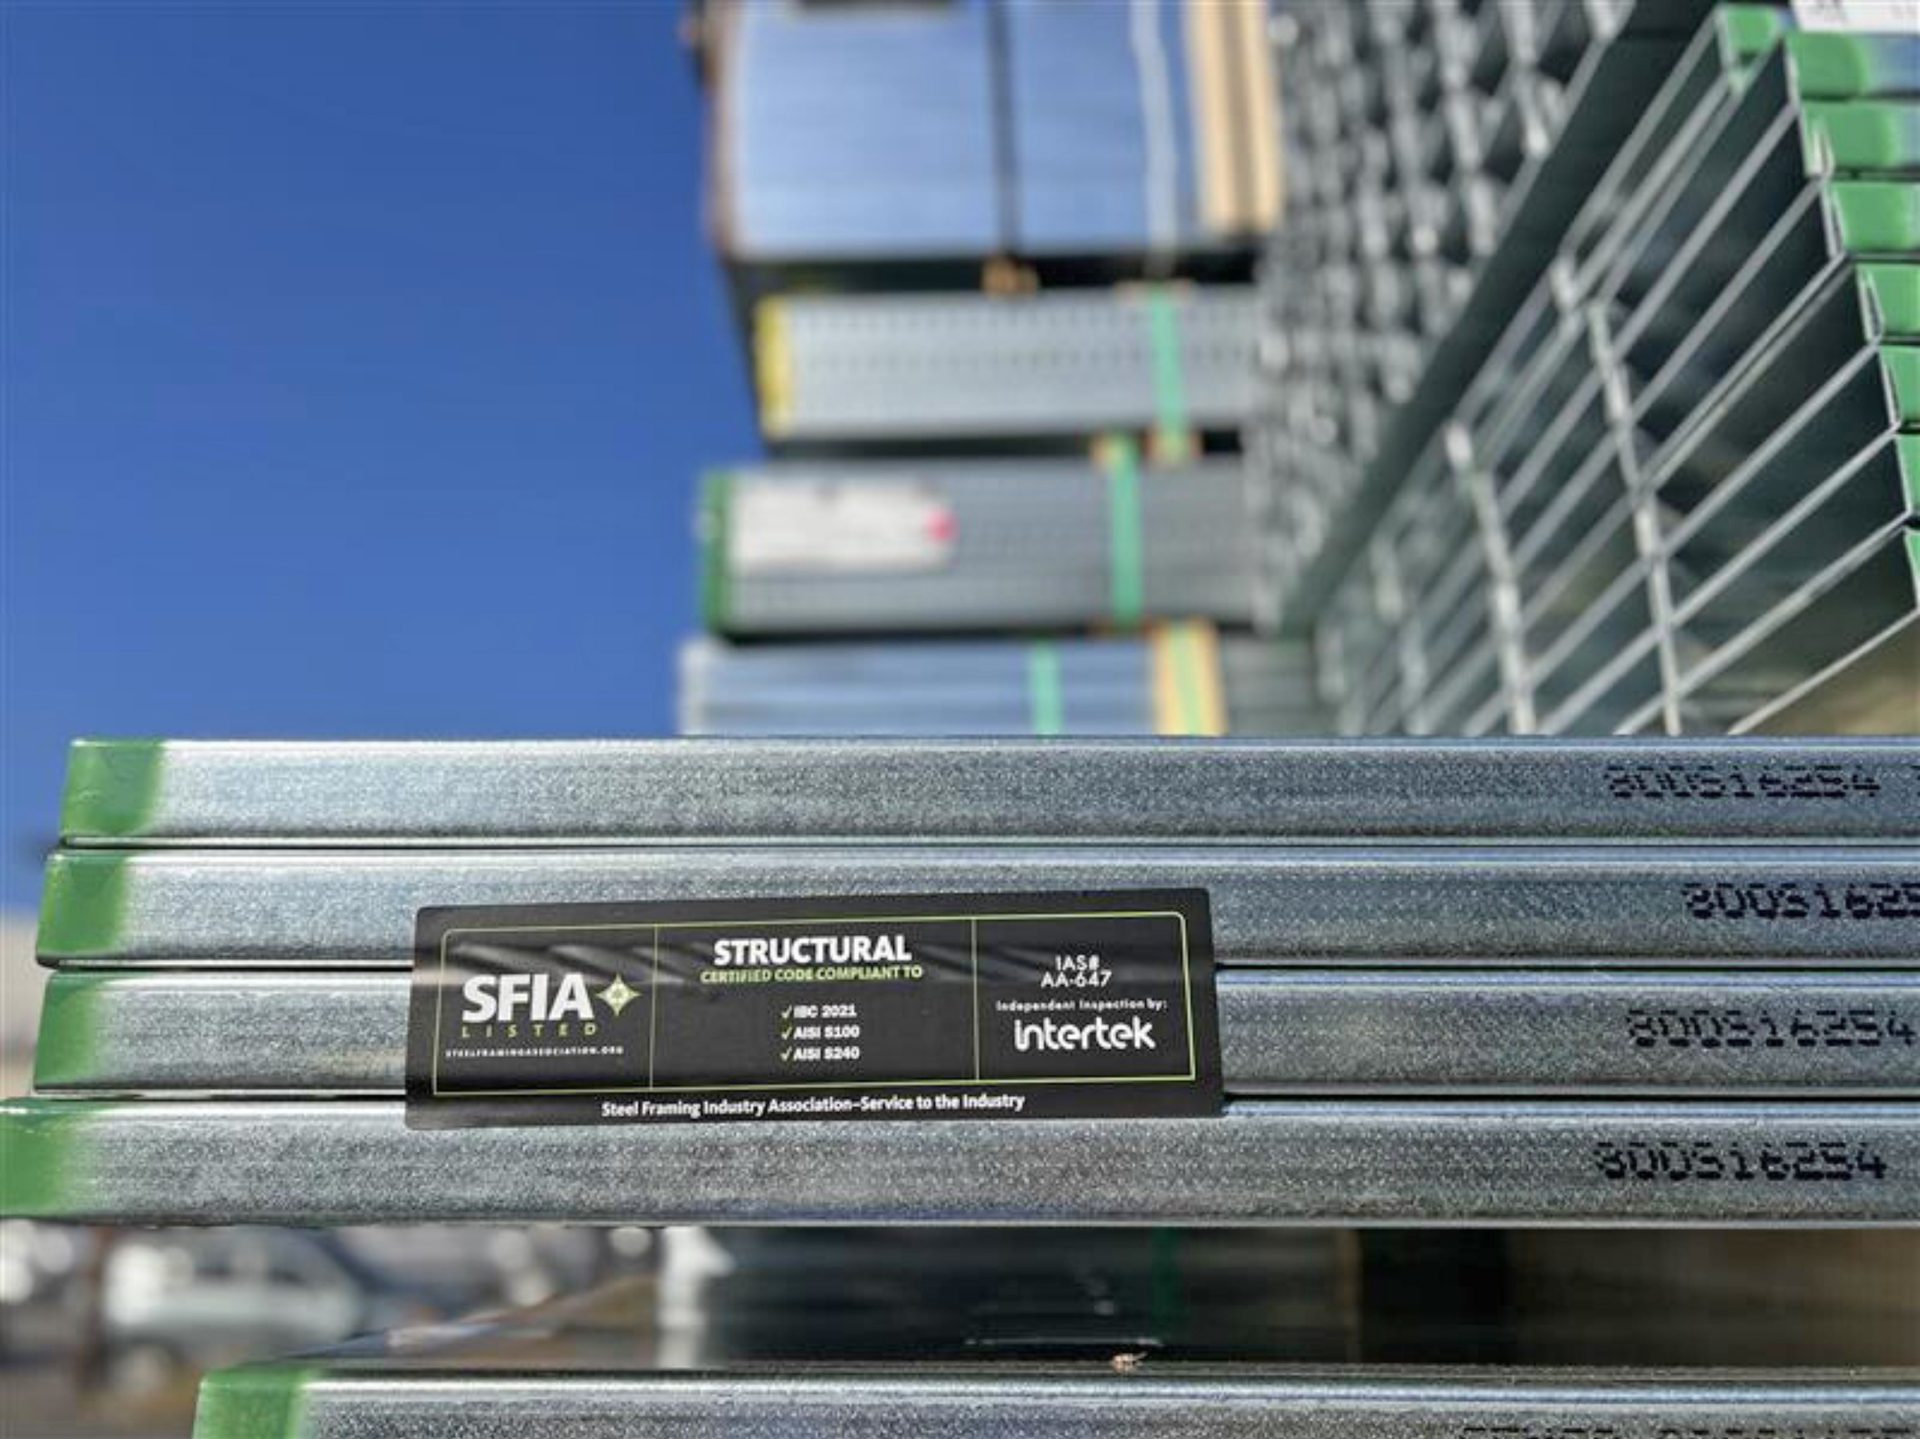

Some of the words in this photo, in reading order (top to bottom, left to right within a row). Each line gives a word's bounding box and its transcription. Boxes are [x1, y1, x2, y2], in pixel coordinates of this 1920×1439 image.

[713, 935, 912, 966] STRUCTURAL
[1055, 954, 1100, 971] IAS#
[700, 970, 771, 984] CERTIFIED
[774, 967, 813, 982] CODE
[815, 966, 899, 981] COMPLIANT
[903, 964, 923, 978] TO
[1040, 970, 1113, 988] AA-647
[461, 973, 596, 1024] SFIA
[996, 1001, 1076, 1013] Independent
[1079, 999, 1144, 1011] Inspection
[1147, 998, 1168, 1012] by:
[794, 1005, 818, 1018] IBC
[822, 1004, 857, 1018] 2021
[461, 1024, 600, 1039] LISTED
[793, 1026, 821, 1040] AISI
[825, 1025, 860, 1039] S100
[1014, 1015, 1156, 1051] intertek
[793, 1047, 821, 1061] AISI
[825, 1046, 860, 1061] S240
[601, 1102, 639, 1117] Steel
[642, 1101, 700, 1119] Framing
[704, 1099, 766, 1117] Industry
[916, 1096, 932, 1110] to
[935, 1095, 959, 1109] the
[963, 1093, 1025, 1112] Industry
